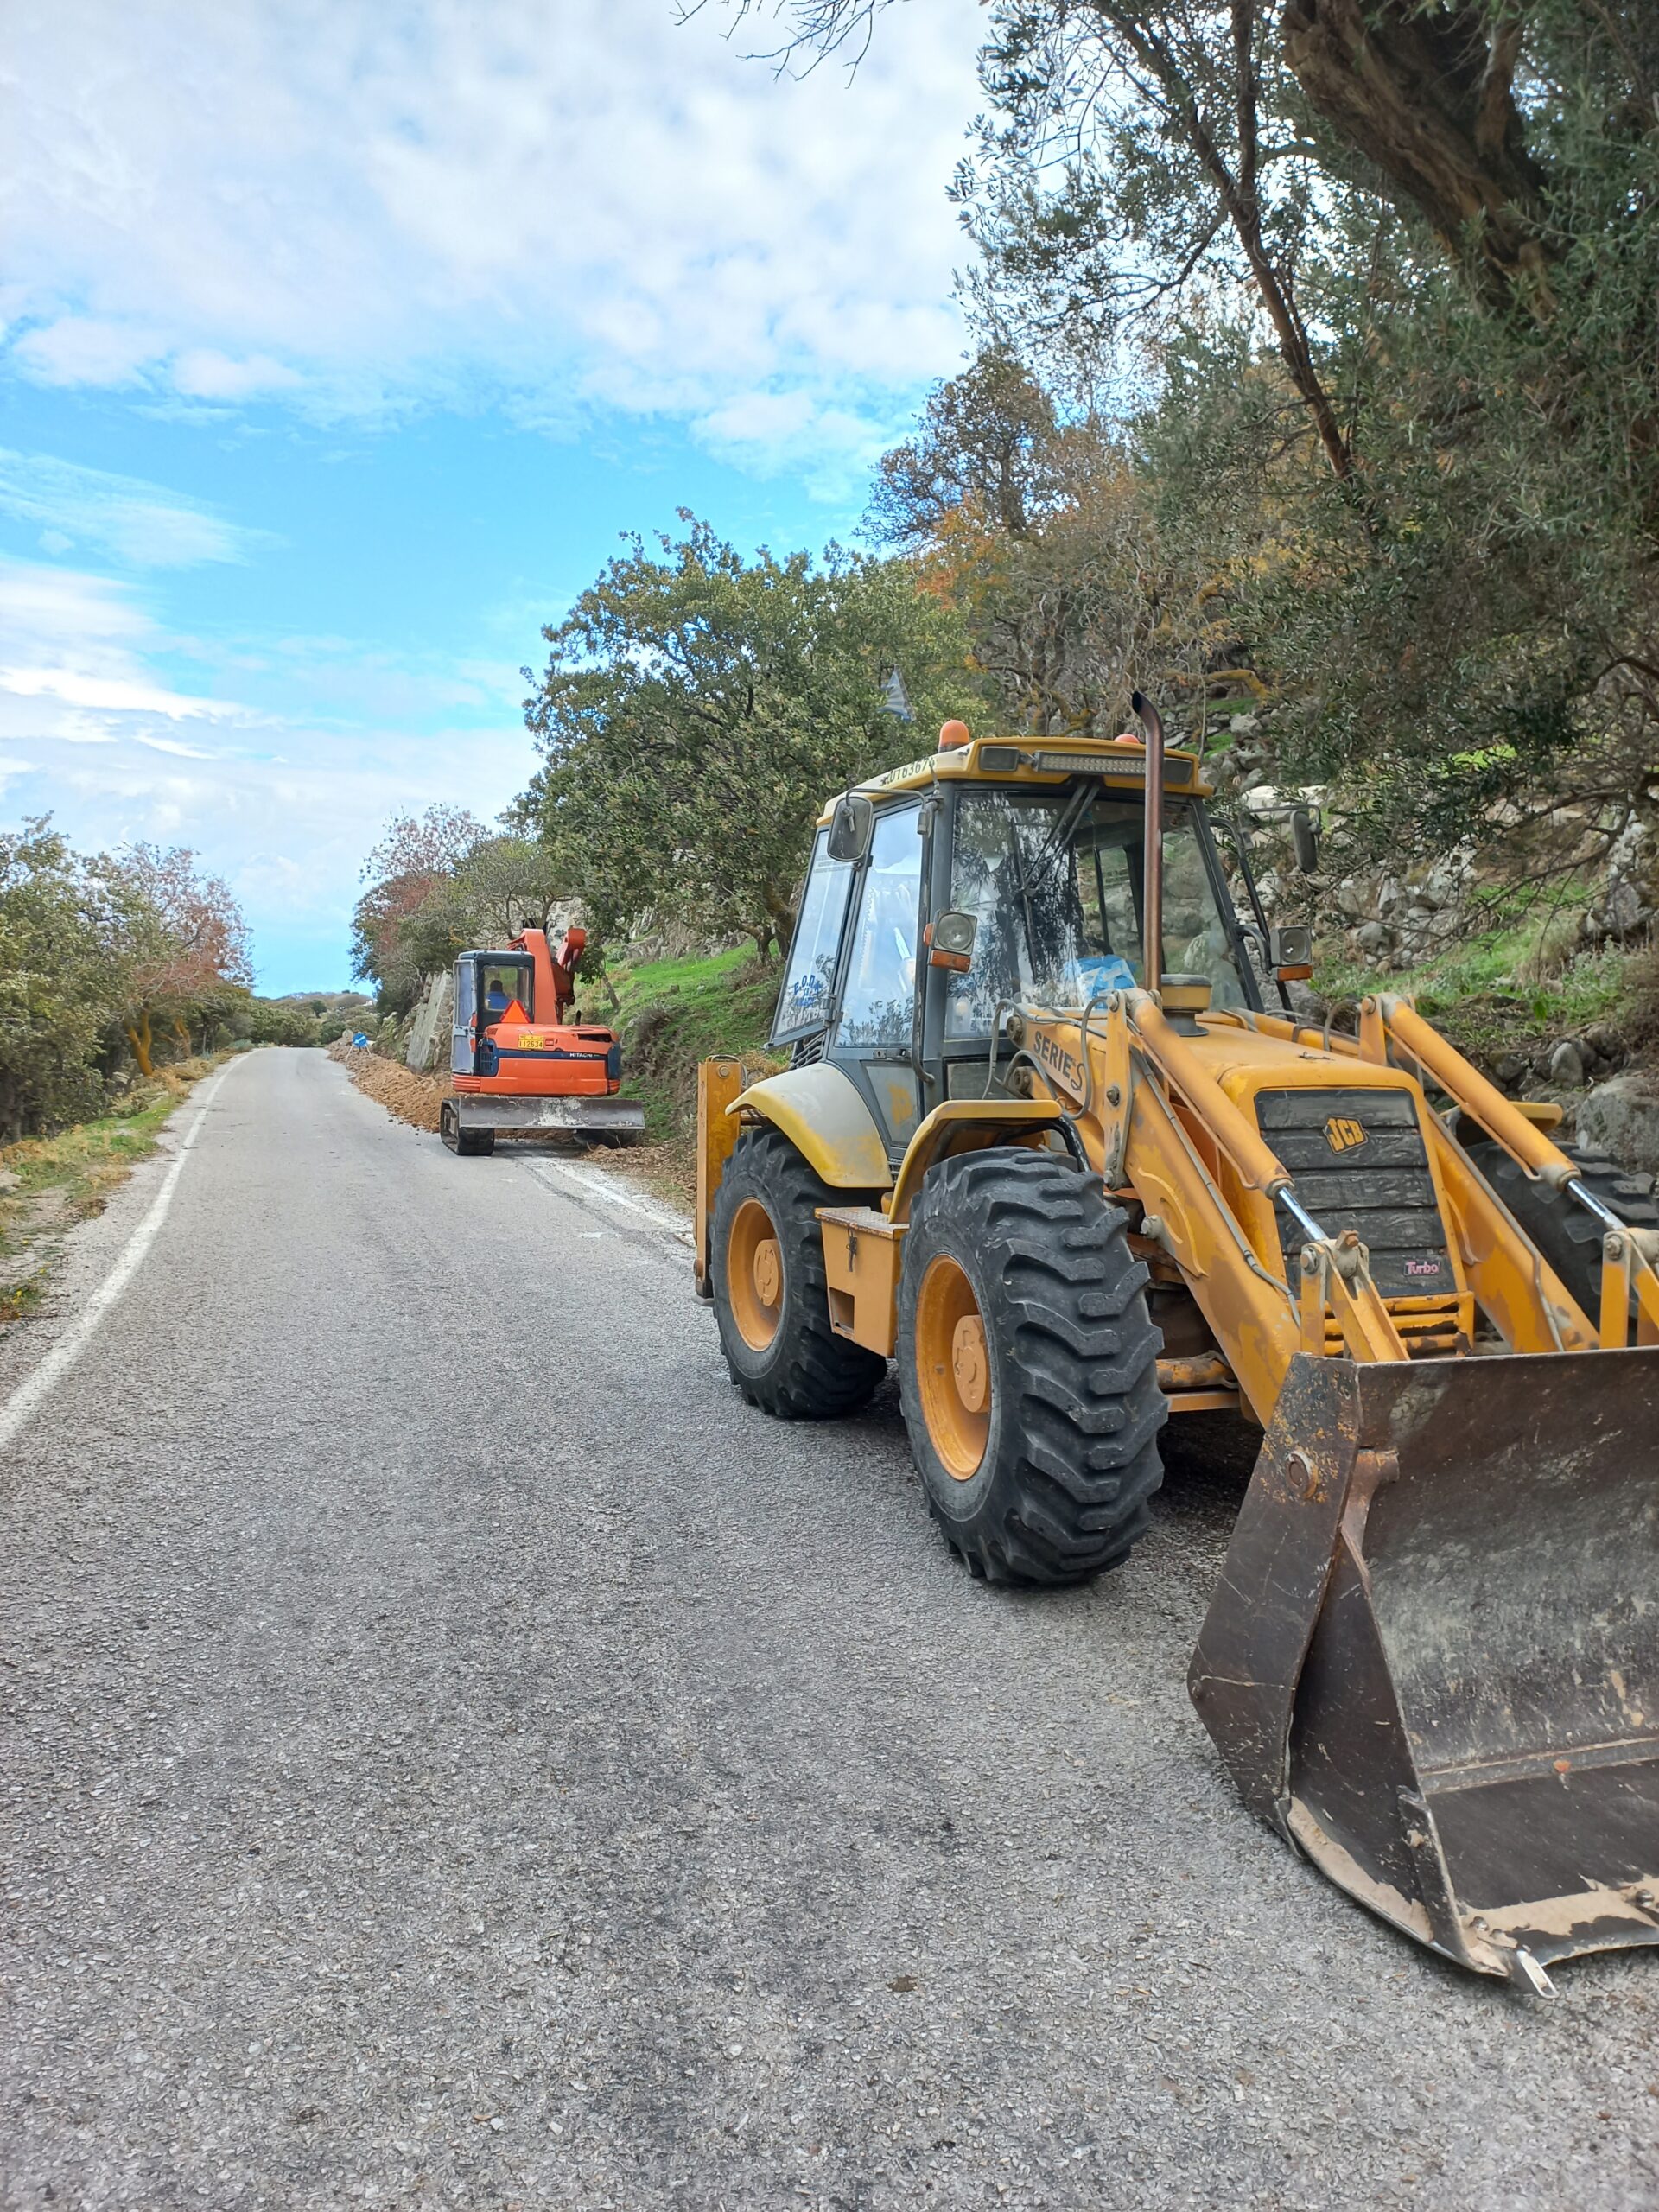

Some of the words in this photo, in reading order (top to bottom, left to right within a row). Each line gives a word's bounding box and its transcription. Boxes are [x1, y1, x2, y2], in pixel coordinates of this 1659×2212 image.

[1033, 1030, 1085, 1092] SERIES
[1327, 1118, 1364, 1151] JCB
[1406, 1261, 1439, 1275] Turbo
